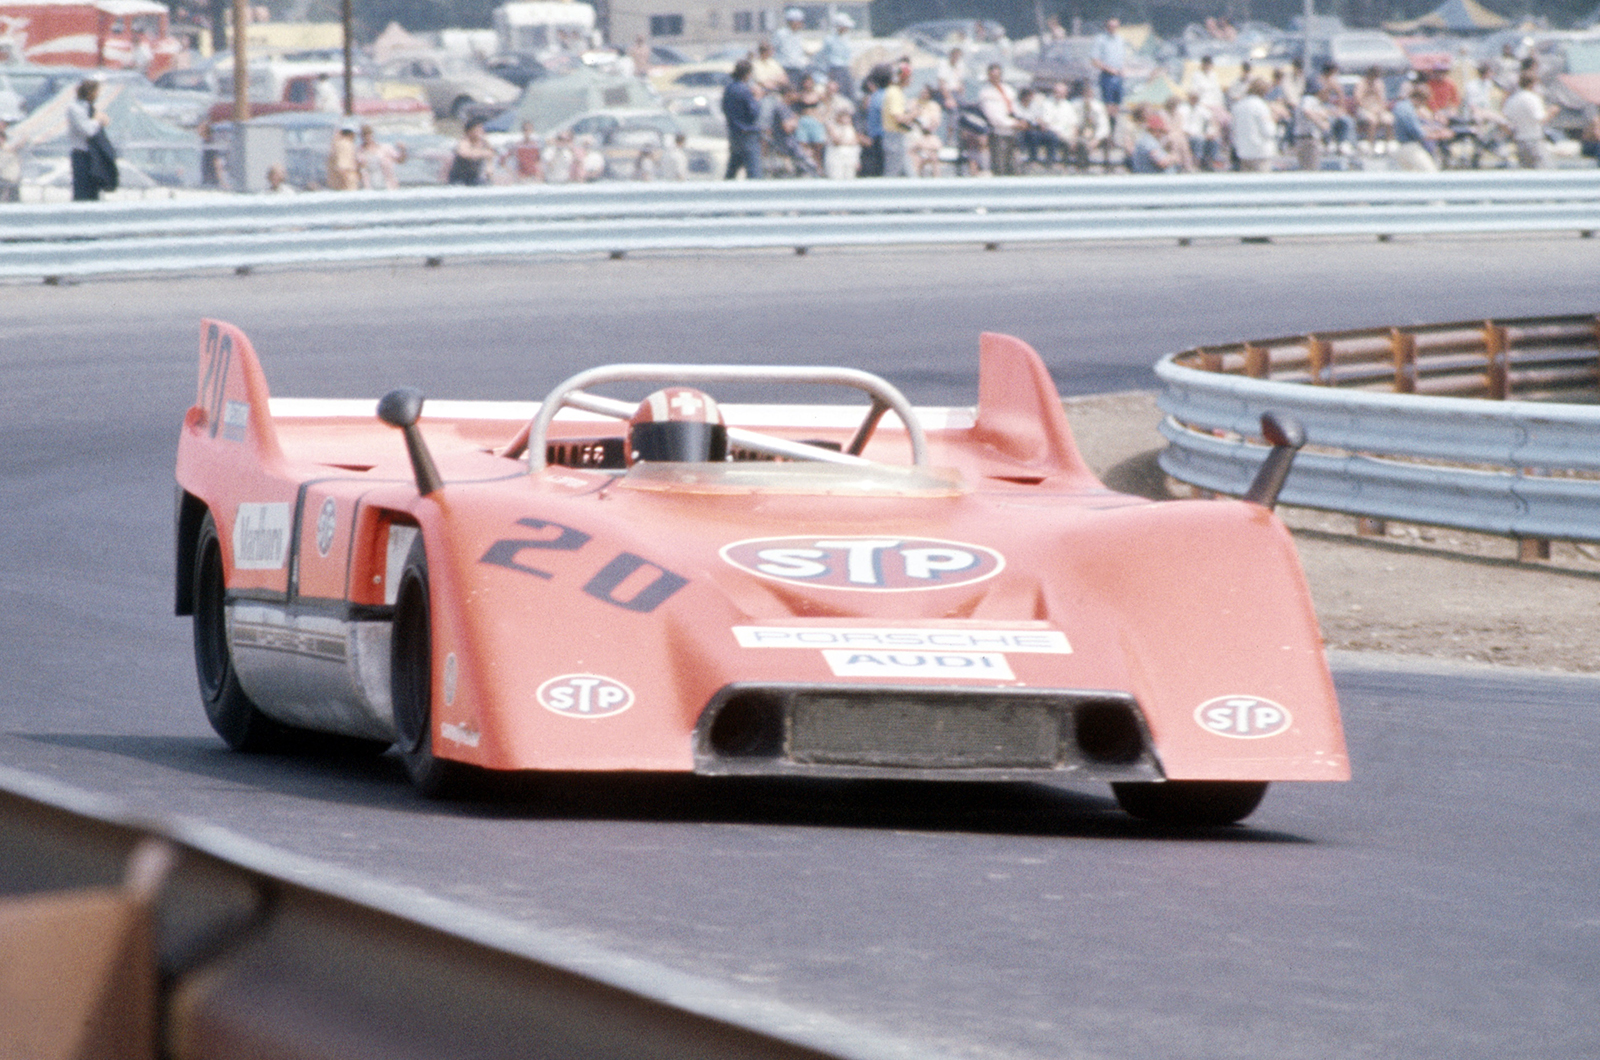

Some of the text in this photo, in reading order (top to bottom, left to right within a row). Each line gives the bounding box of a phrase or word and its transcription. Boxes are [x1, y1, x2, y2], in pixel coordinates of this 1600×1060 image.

[479, 517, 690, 613] 20
[756, 539, 982, 587] STP
[753, 630, 1053, 649] PORSCHE
[846, 653, 995, 669] AUDI
[548, 679, 625, 713] STP
[1207, 700, 1283, 734] STP
